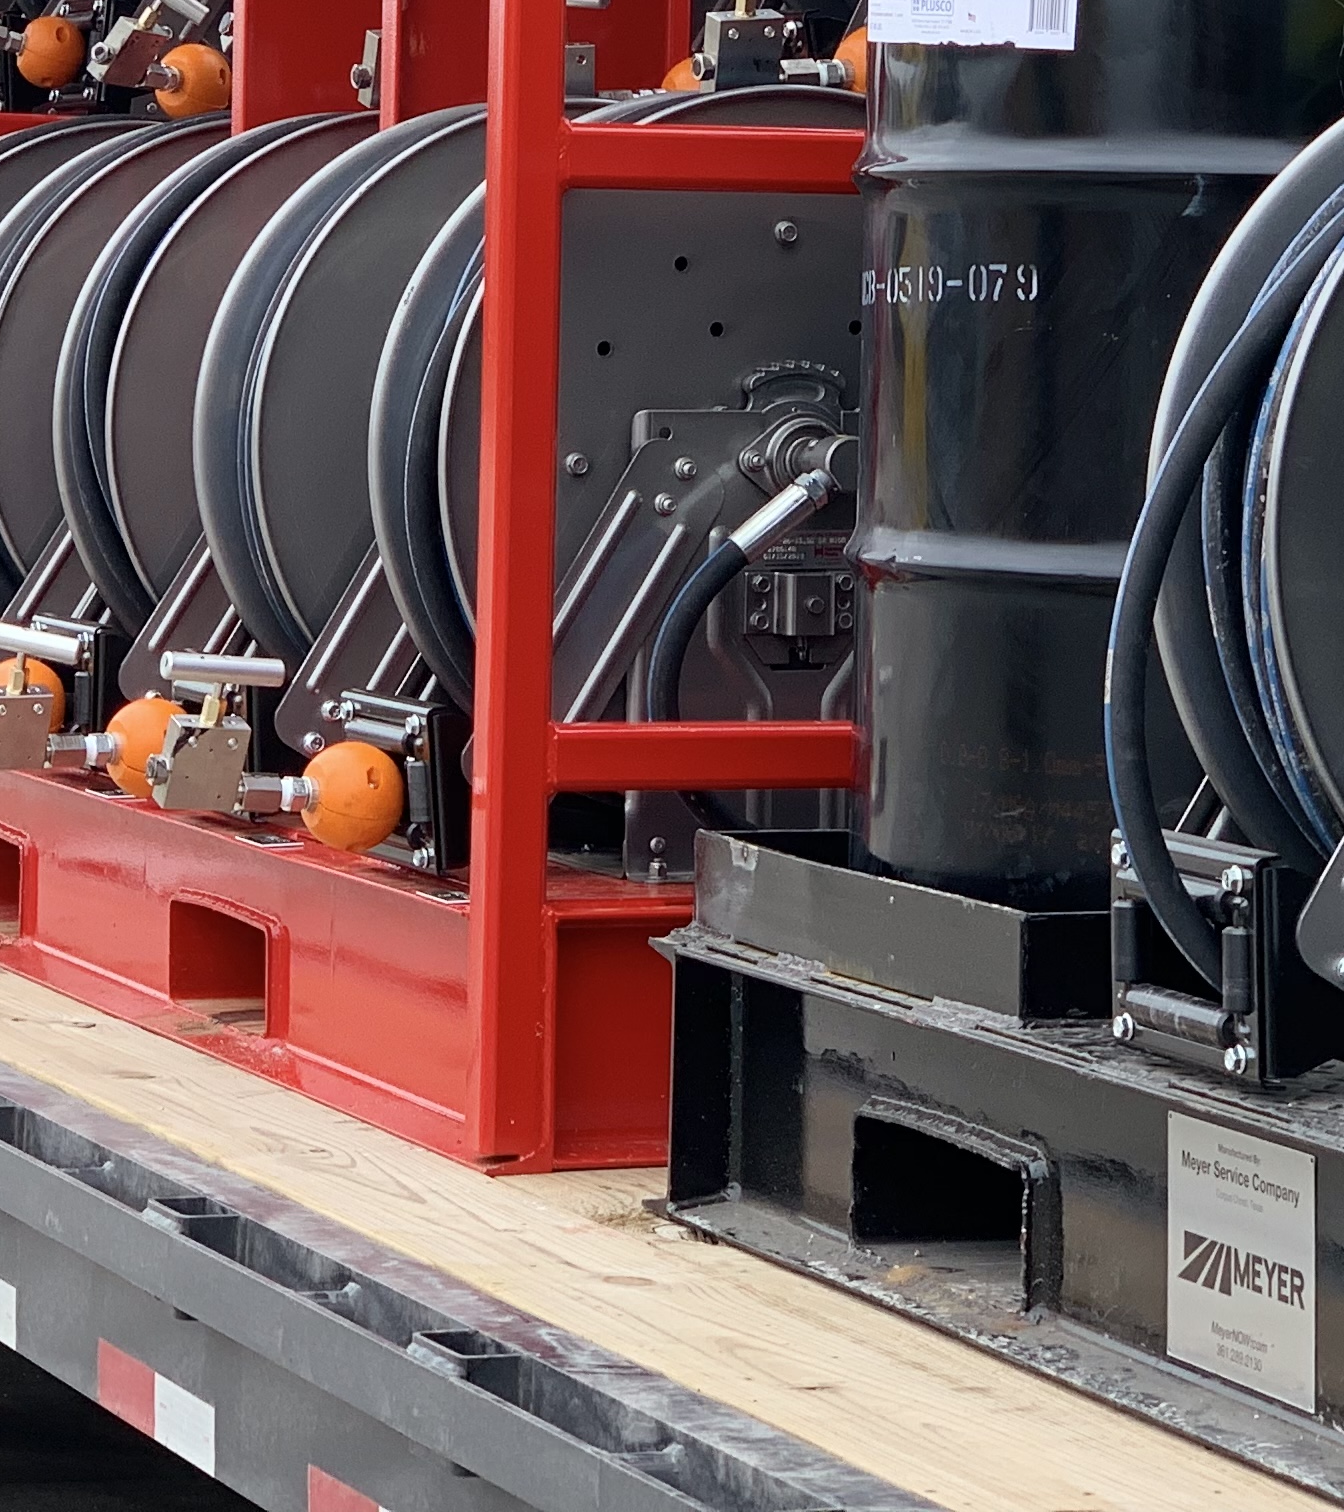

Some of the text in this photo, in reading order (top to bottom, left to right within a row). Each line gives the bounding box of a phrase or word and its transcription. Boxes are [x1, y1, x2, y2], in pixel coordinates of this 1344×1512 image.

[921, 0, 952, 12] PLUSCO
[1181, 1150, 1300, 1208] Meyer Service Company
[1234, 1248, 1305, 1310] MEYER
